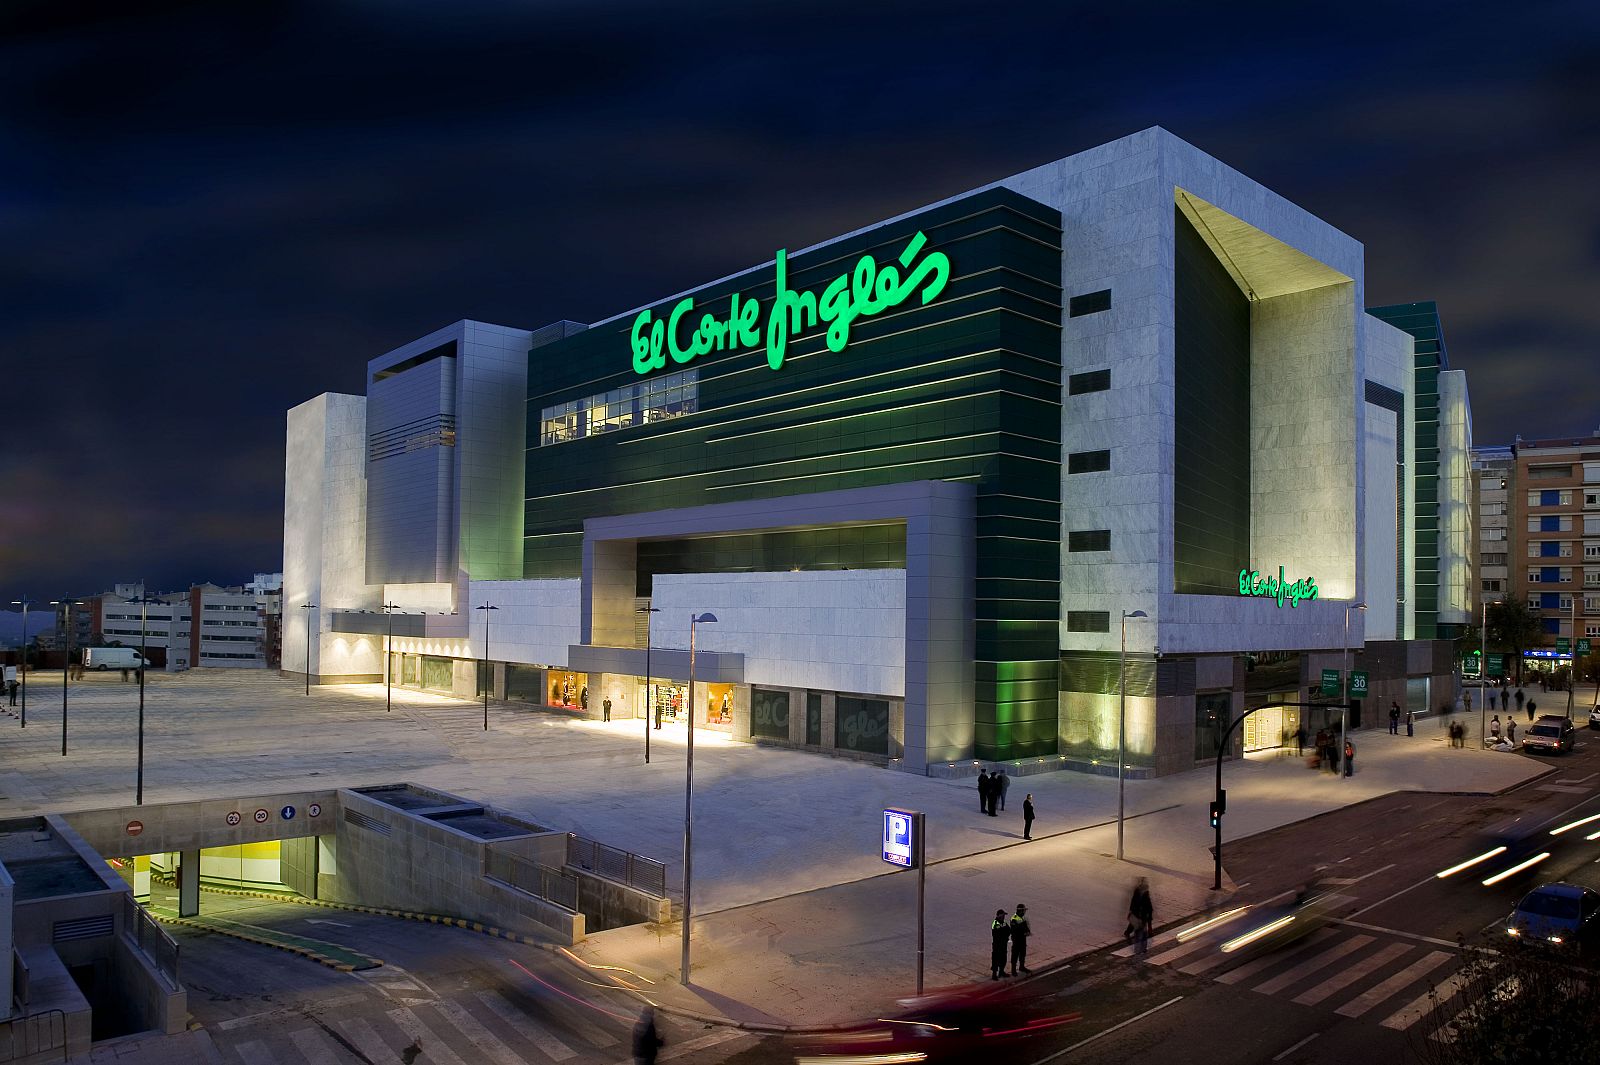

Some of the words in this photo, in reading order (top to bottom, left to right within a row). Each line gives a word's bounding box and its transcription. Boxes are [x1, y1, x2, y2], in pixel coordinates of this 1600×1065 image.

[631, 309, 666, 374] El
[667, 293, 760, 364] Corte
[766, 230, 950, 370] Inglés
[1239, 569, 1251, 595] El
[1251, 570, 1278, 597] Corte
[1277, 565, 1319, 608] Inglés
[1466, 659, 1476, 667] 30
[1354, 678, 1366, 688] 30
[257, 812, 266, 820] 20
[889, 815, 907, 843] P
